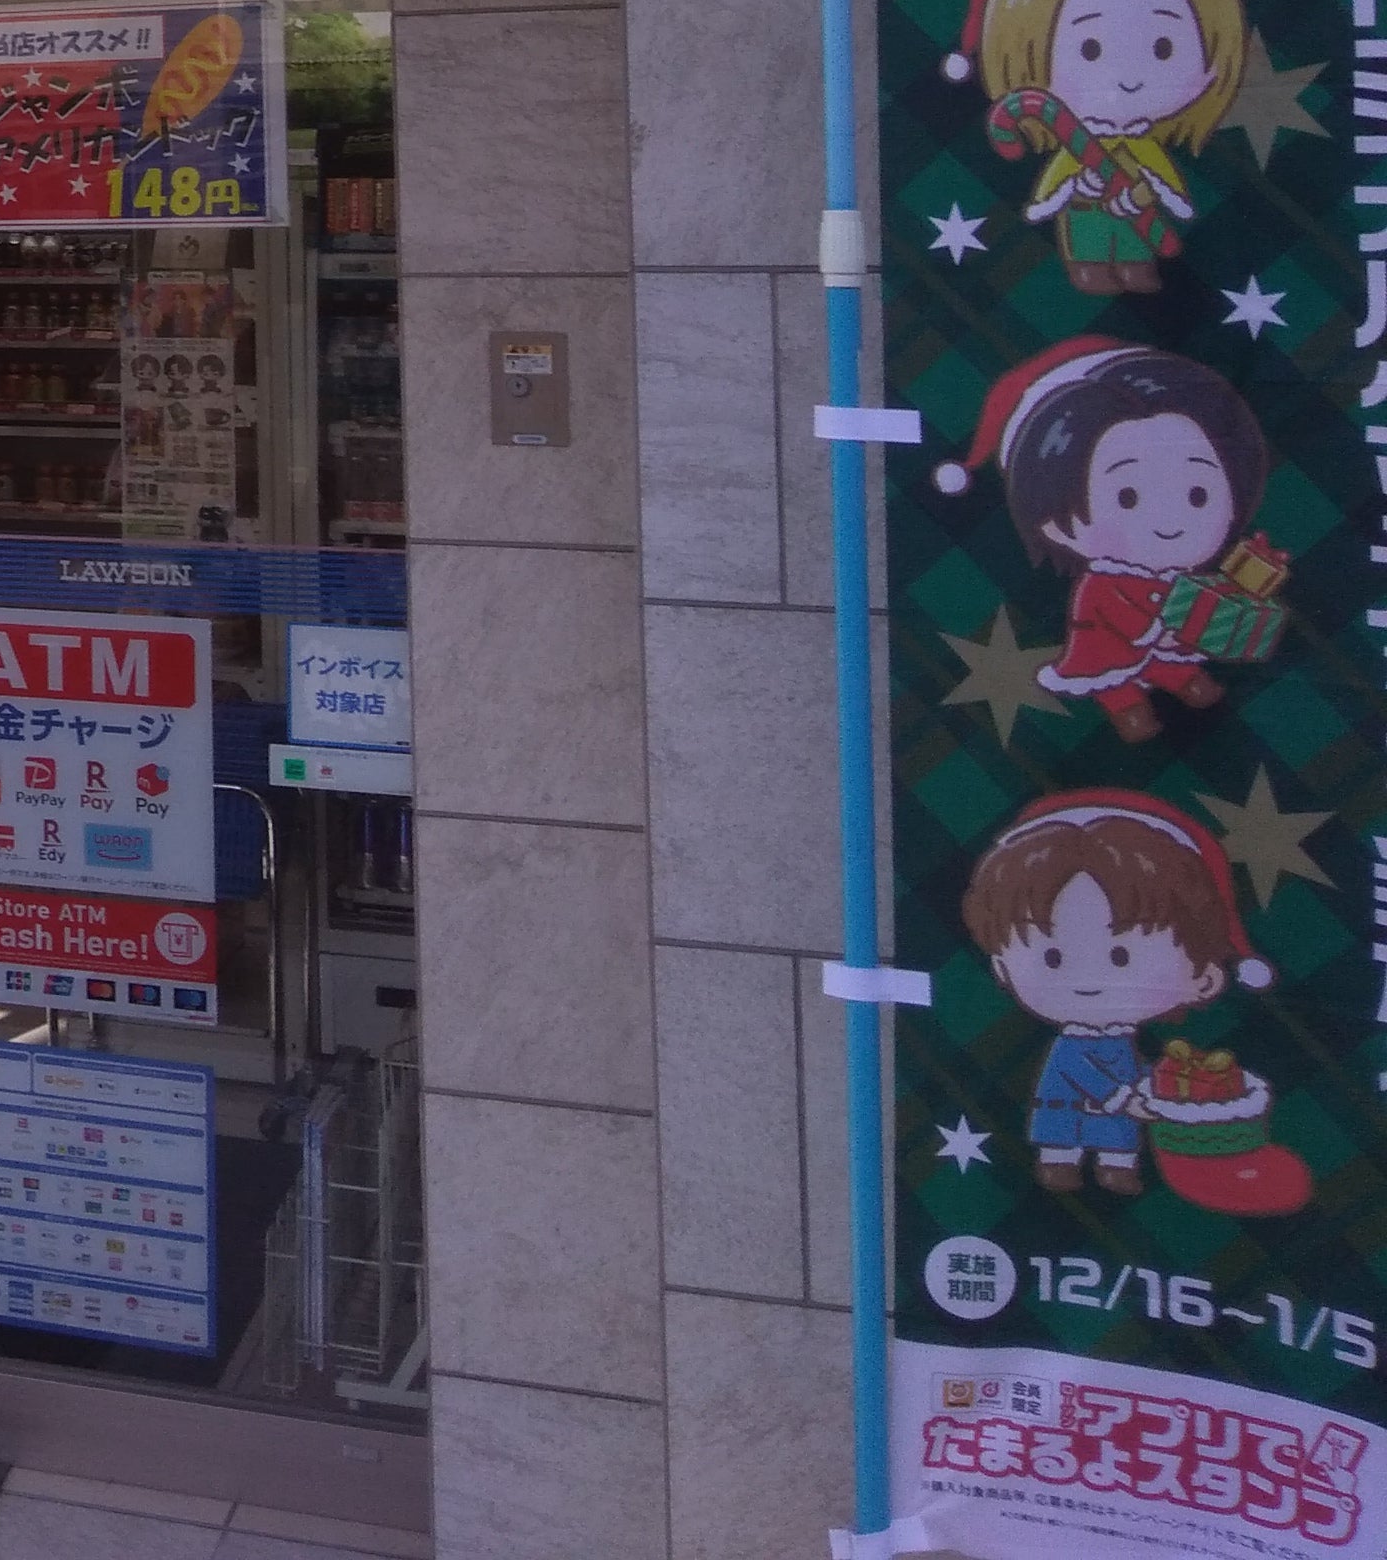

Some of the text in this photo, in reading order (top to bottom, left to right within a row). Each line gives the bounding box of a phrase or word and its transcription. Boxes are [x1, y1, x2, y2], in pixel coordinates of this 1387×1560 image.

[59, 559, 193, 586] LAWSON
[297, 655, 404, 680] インボイス
[315, 690, 386, 716] 対象店
[15, 791, 67, 809] PayPay
[80, 794, 115, 814] Pay
[135, 797, 169, 819] Pay
[39, 848, 67, 865] Edy
[59, 903, 107, 925] ATM
[64, 926, 148, 961] Here!
[947, 1253, 996, 1275] 実施
[947, 1278, 996, 1303] 期間
[1076, 1390, 1301, 1479] アプリで
[926, 1419, 1360, 1543] たまるよスタンプ
